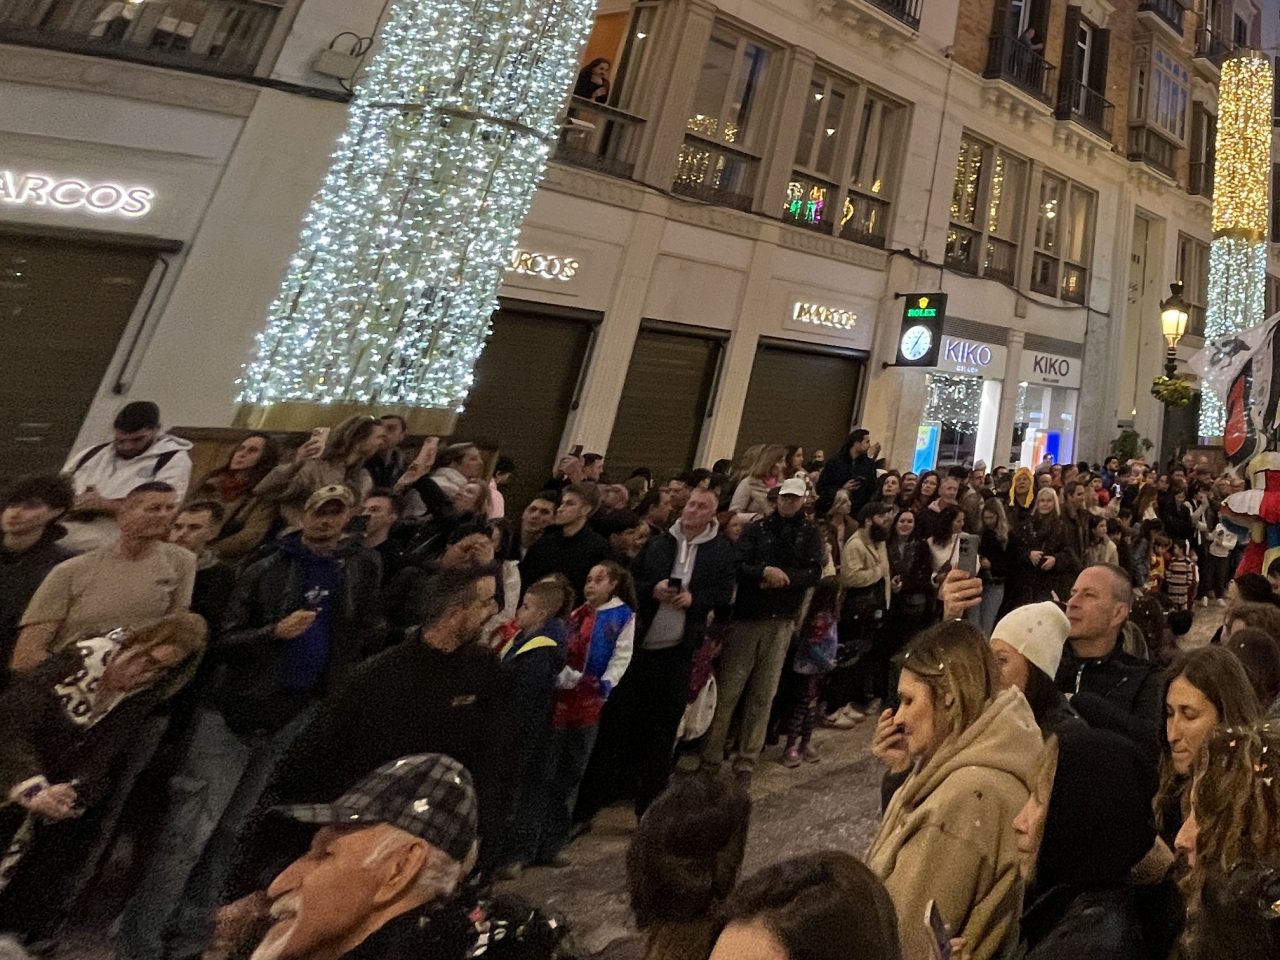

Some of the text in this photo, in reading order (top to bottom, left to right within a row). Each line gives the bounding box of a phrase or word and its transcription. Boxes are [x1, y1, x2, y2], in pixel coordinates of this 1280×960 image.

[908, 309, 936, 317] ROLEX
[944, 339, 992, 366] KIKO
[1033, 355, 1070, 377] KIKO
